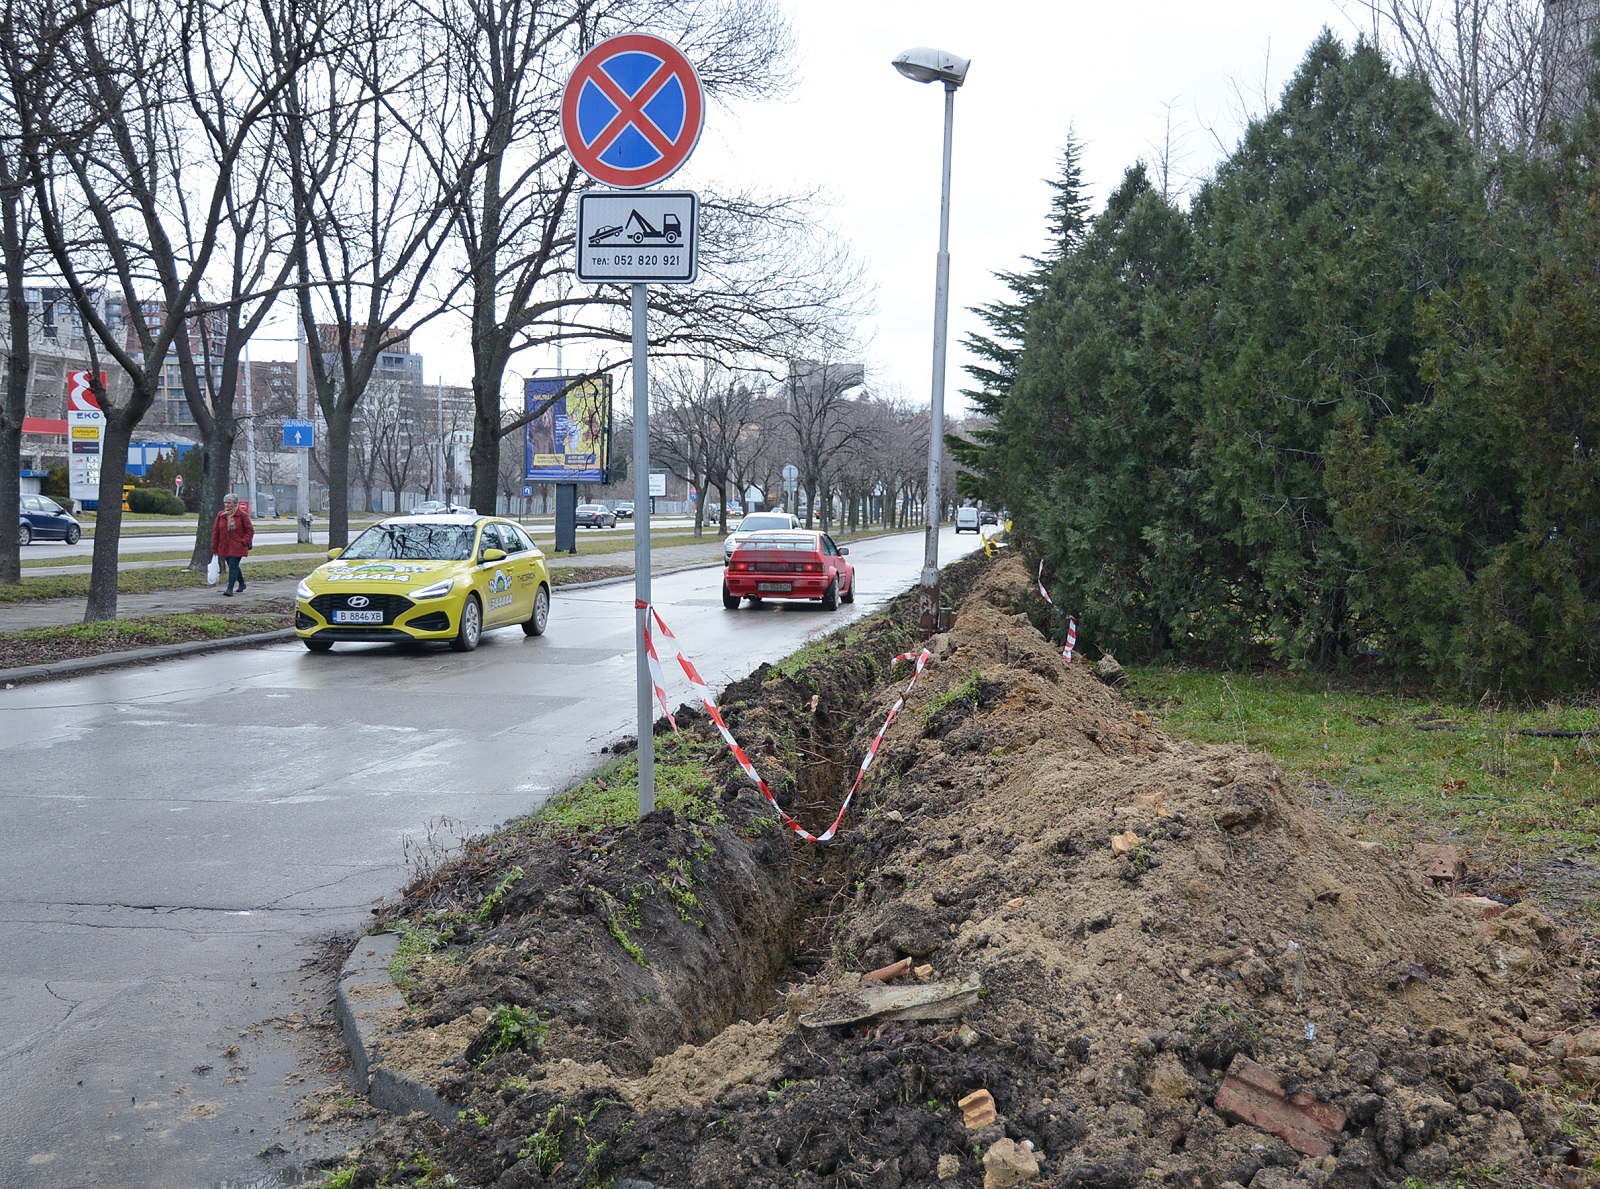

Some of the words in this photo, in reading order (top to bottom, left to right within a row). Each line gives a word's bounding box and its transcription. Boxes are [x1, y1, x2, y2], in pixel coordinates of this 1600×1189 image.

[592, 257, 609, 266] тел:
[614, 255, 633, 266] 052
[638, 255, 658, 266] 820
[663, 255, 680, 266] 921
[340, 612, 347, 621] B
[349, 612, 369, 621] 8846
[370, 612, 382, 621] XB
